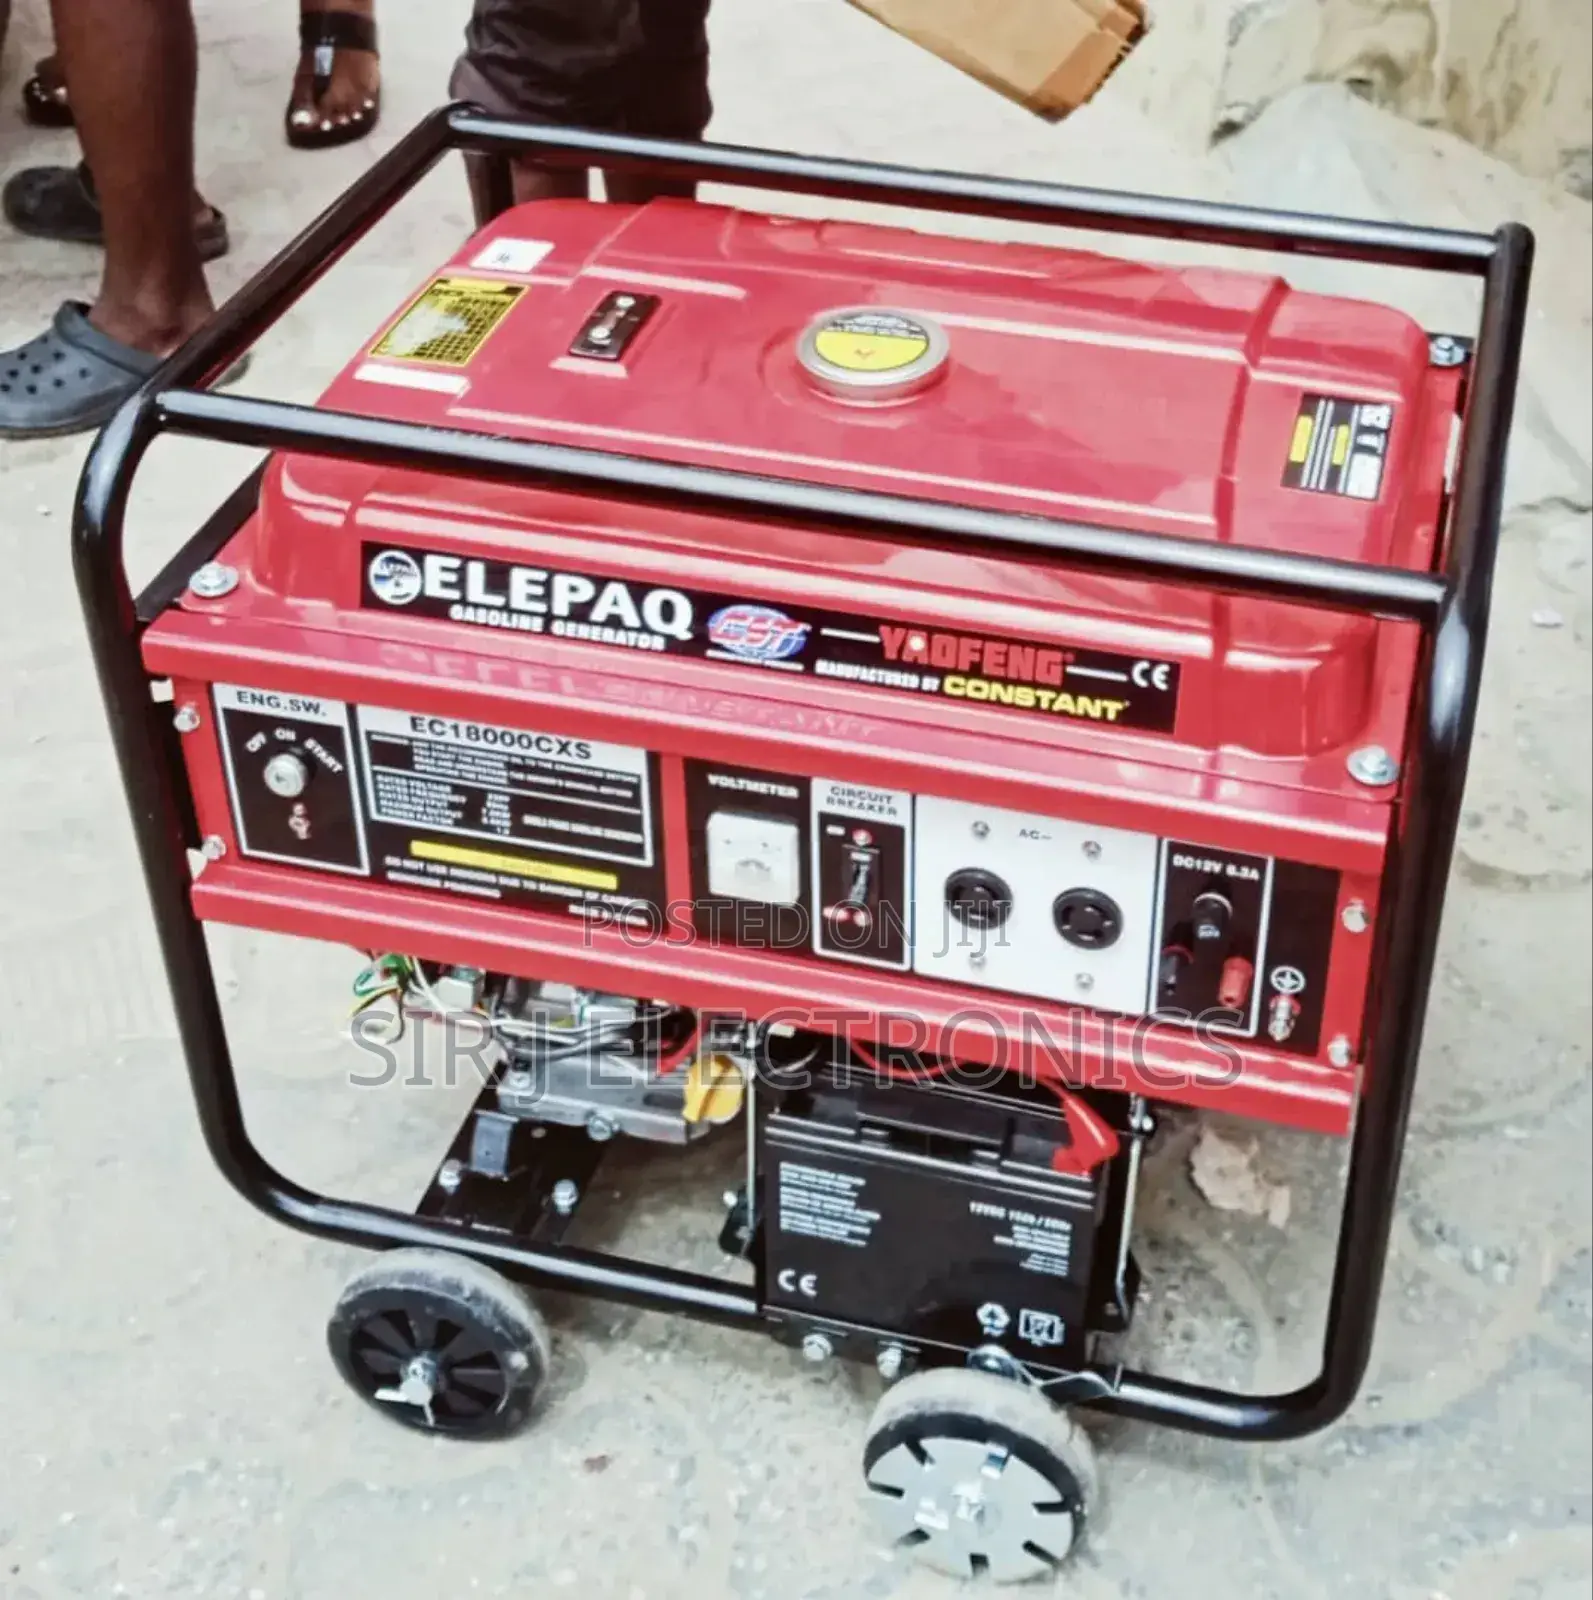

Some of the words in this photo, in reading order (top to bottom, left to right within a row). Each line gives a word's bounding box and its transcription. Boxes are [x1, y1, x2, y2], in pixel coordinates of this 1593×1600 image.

[423, 554, 694, 641] ELEPAQ
[449, 604, 543, 632] GASOLINE
[551, 619, 665, 651] GENERATOR
[878, 624, 1067, 686] YAOFENG
[236, 689, 328, 717] ENG.SW.
[814, 658, 920, 690] MANUFACTURED
[921, 675, 940, 692] BY
[942, 675, 1126, 722] CONSTANT
[274, 727, 297, 741] ON
[409, 715, 593, 761] EC18000CXS
[303, 736, 344, 774] START
[707, 774, 799, 799] VOLTMETER
[831, 785, 894, 805] CIRCUIT
[826, 796, 898, 816] BREAKER
